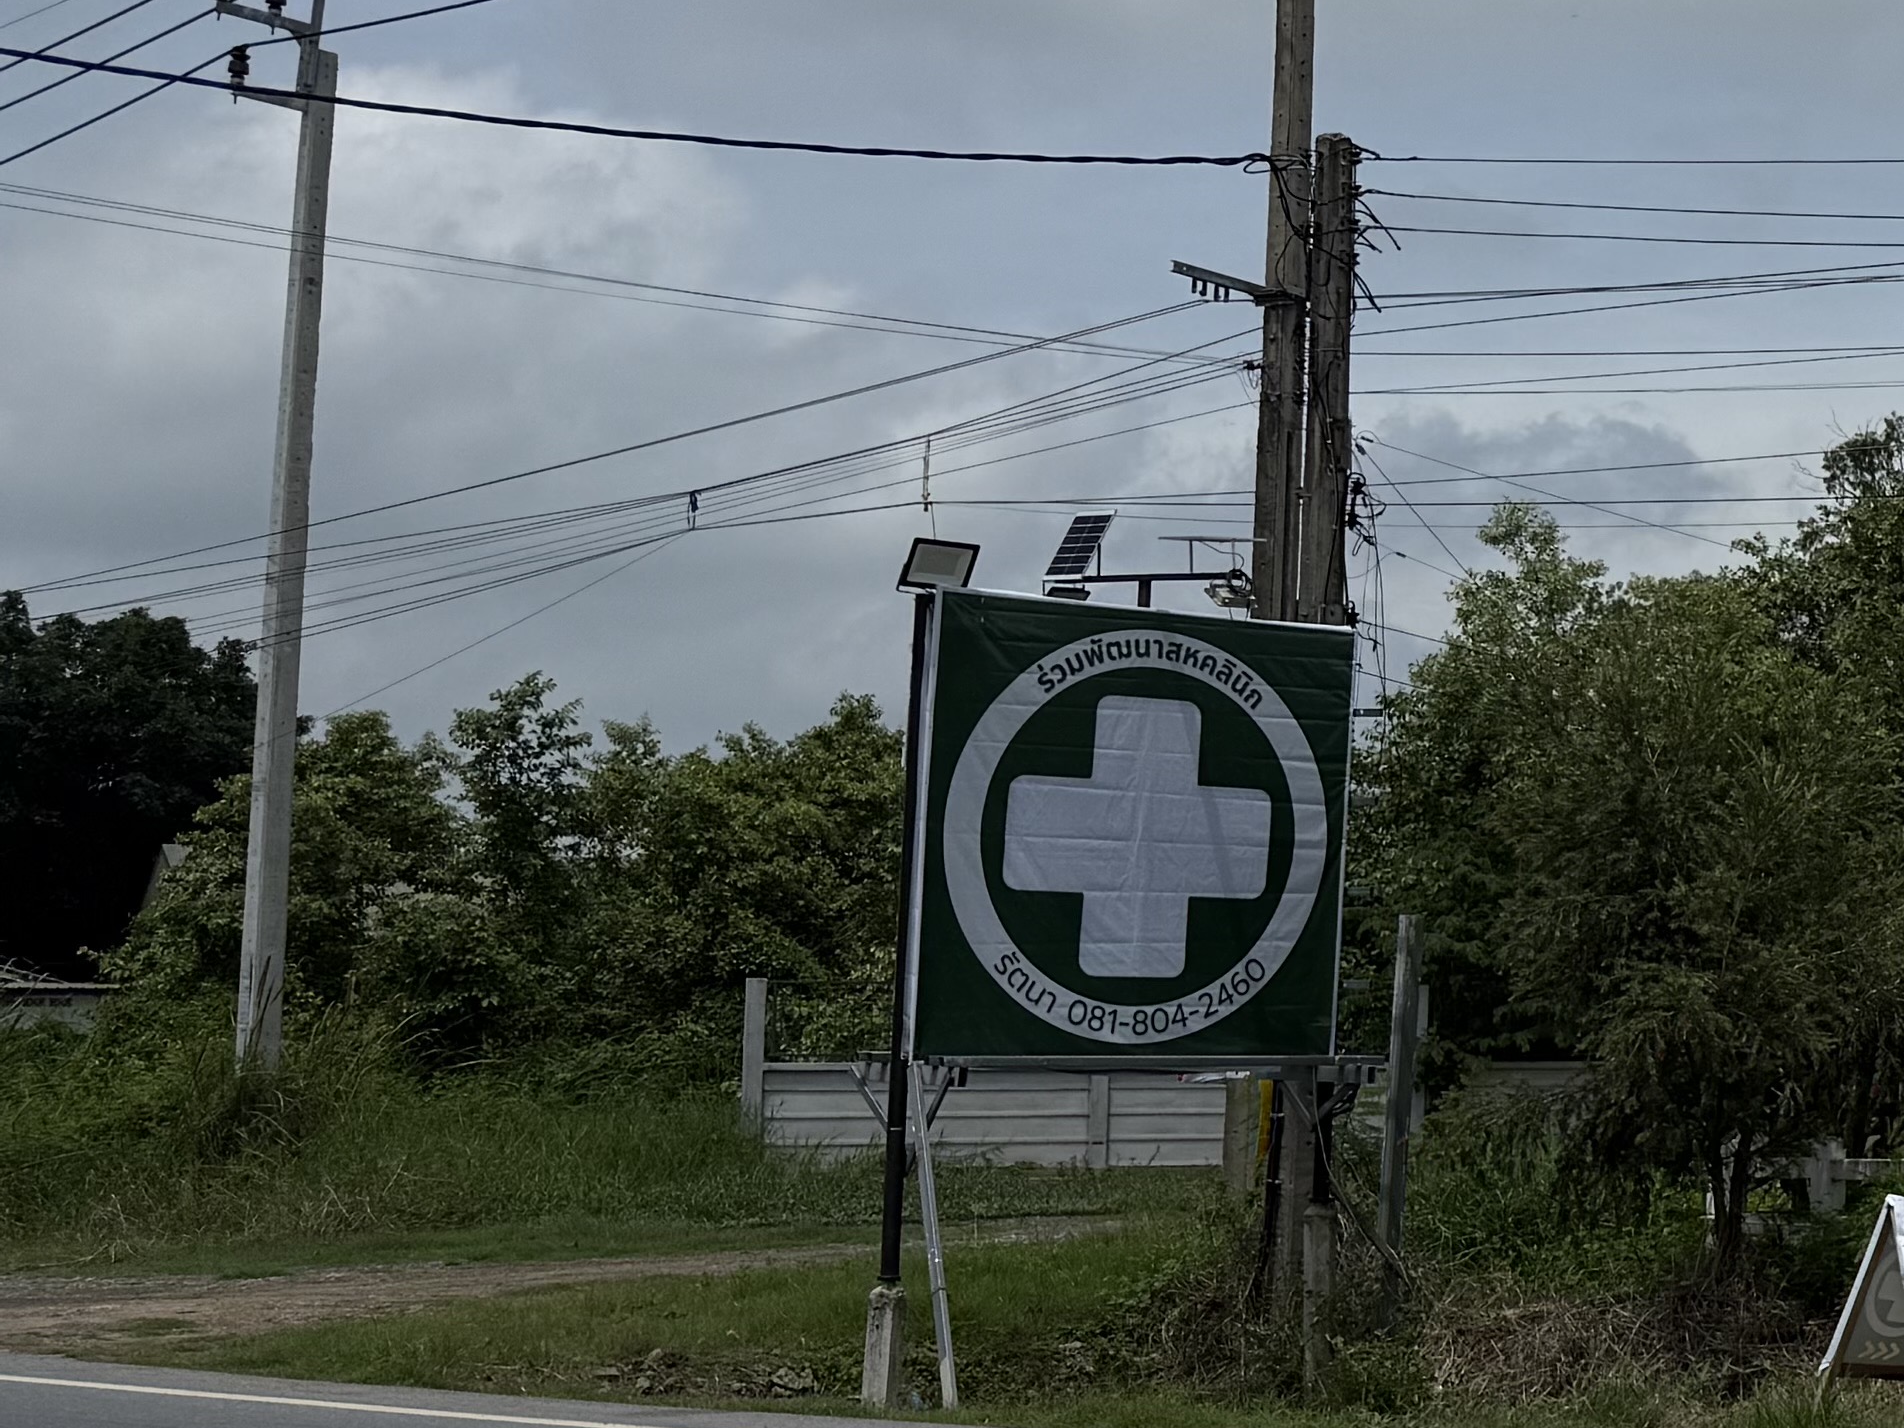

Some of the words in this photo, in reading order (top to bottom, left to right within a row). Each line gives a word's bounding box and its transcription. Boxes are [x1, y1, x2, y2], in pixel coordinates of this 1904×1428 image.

[1037, 638, 1263, 710] ร่วมพัฒนาสหคลินิก
[994, 951, 1057, 1014] รัตนา
[1067, 958, 1266, 1036] 081-804-2460
